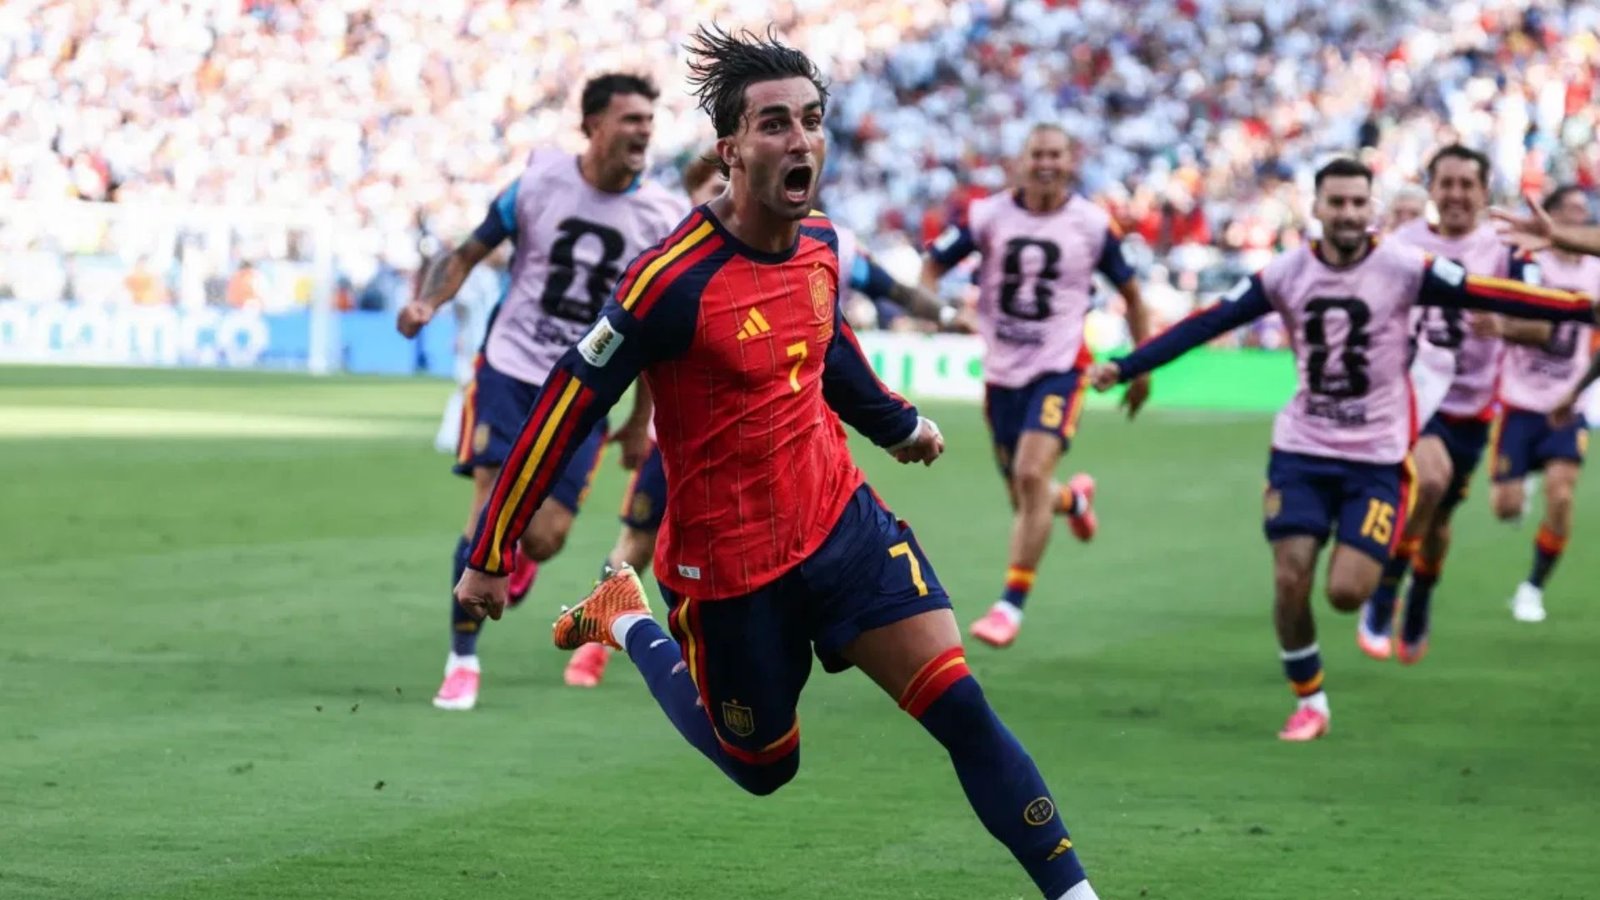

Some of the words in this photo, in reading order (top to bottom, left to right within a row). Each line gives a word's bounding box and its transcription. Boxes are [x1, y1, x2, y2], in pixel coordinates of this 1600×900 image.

[786, 341, 808, 393] 7
[1040, 394, 1065, 428] 5
[1361, 497, 1395, 545] 15
[888, 541, 929, 597] 7
